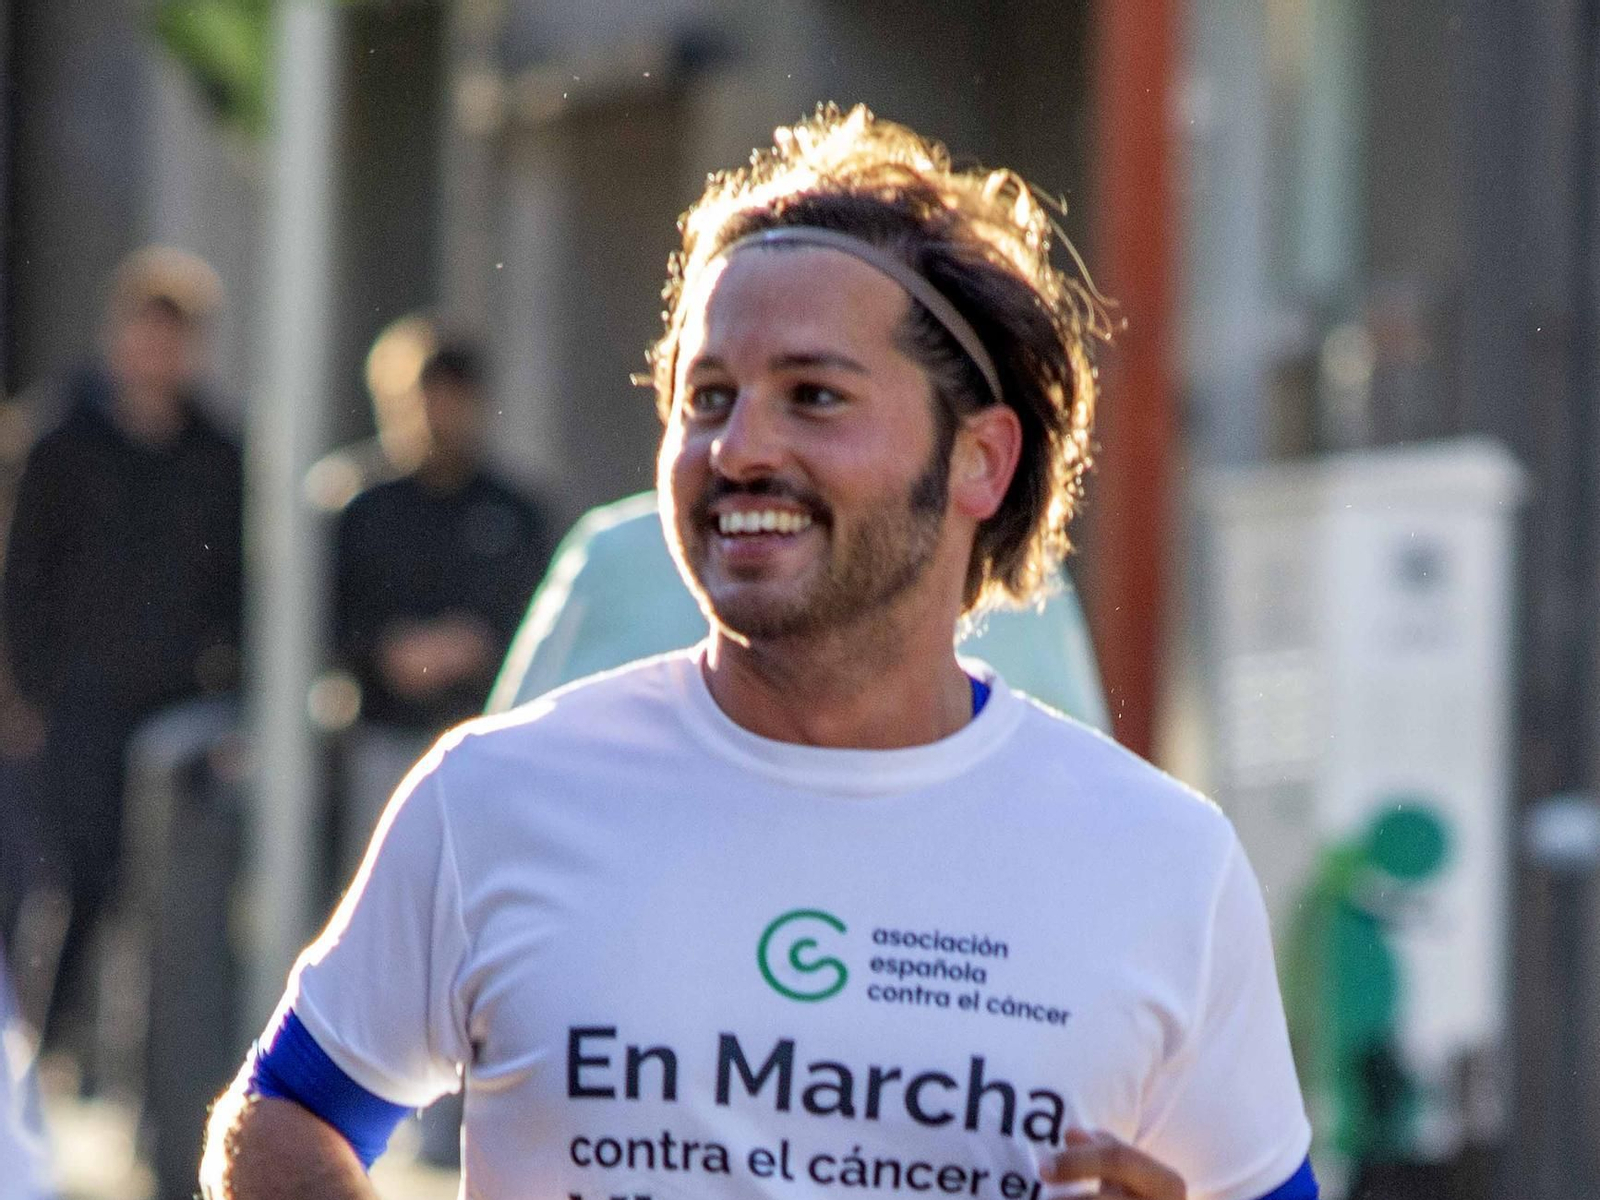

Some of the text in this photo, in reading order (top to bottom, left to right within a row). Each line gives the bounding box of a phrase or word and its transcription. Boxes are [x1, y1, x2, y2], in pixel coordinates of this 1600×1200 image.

[872, 928, 1009, 959] asociación
[870, 957, 988, 985] española
[866, 983, 1072, 1026] contra el cáncer
[566, 1026, 1066, 1147] En Marcha
[569, 1130, 730, 1174] contra
[748, 1140, 794, 1181] el
[808, 1145, 989, 1196] cáncer
